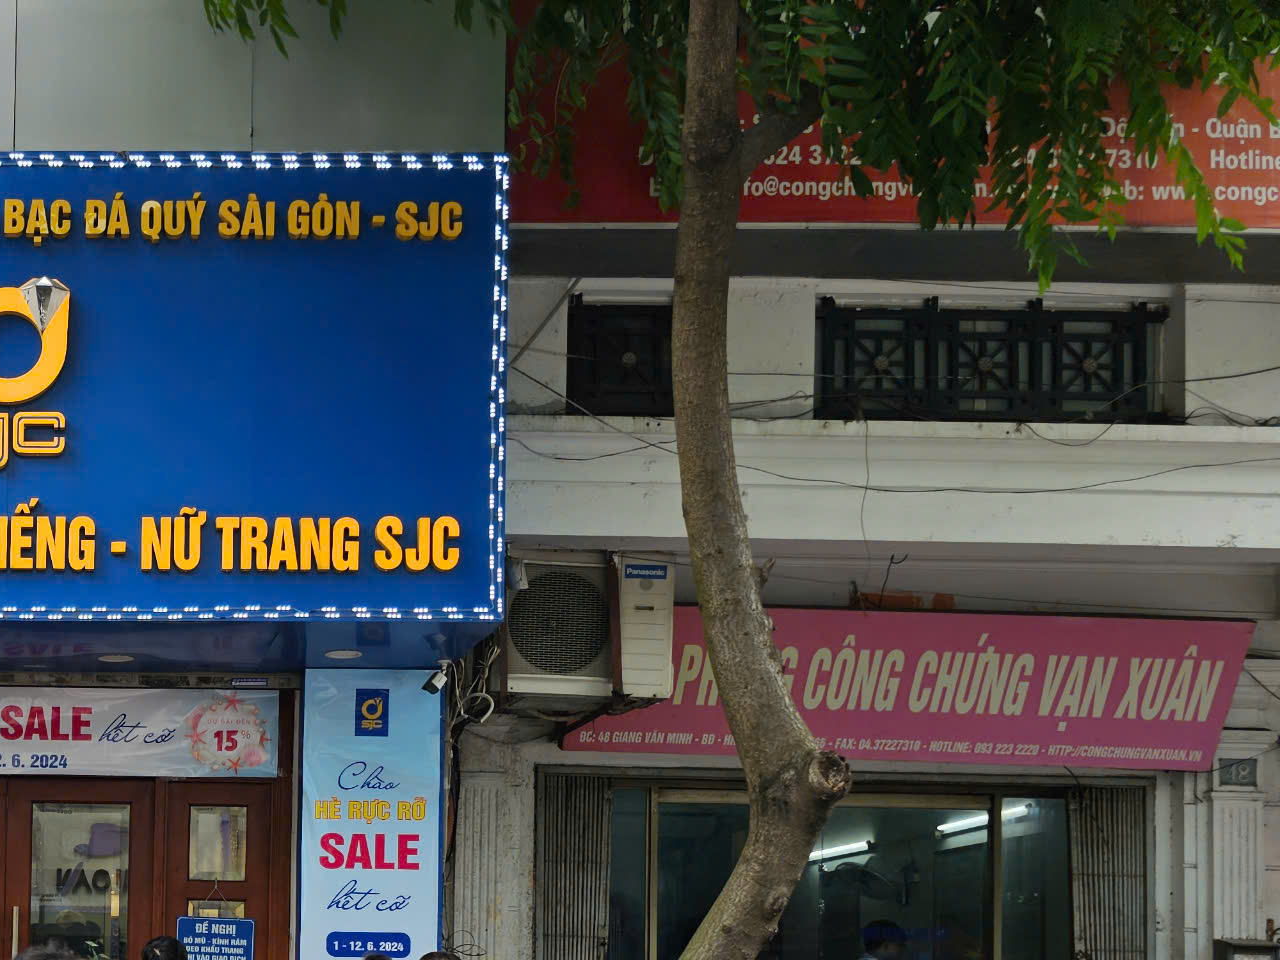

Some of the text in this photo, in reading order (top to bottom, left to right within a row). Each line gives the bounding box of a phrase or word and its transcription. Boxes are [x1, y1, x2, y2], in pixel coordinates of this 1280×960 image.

[1206, 117, 1262, 145] Quận
[4, 199, 71, 245] BẠC
[84, 192, 130, 238] ĐÁ
[141, 192, 207, 242] QUÝ
[218, 193, 276, 239] SÀI
[287, 193, 361, 239] GÒN
[371, 213, 386, 227] -
[395, 201, 463, 240] SJC
[111, 541, 127, 554] -
[141, 506, 207, 571] NỮ
[215, 515, 360, 571] TRANG
[374, 516, 460, 571] SJC
[626, 567, 665, 577] Panasonic
[803, 634, 905, 712] CÔNG
[909, 633, 1035, 716] CHỨNG
[1038, 655, 1119, 732] VẠN
[1114, 645, 1225, 723] XUÂN
[0, 705, 93, 742] SALE
[98, 713, 147, 742] hết
[598, 731, 610, 743] 48
[612, 731, 642, 743] GIANG
[645, 730, 665, 744] VĂN
[666, 733, 693, 745] MINH
[835, 738, 857, 749] FAX:
[929, 741, 971, 753] HOTLINE:
[30, 754, 68, 769] 2024
[337, 761, 400, 791] Chào
[315, 796, 428, 825] HÈ RỰC RỠ
[319, 832, 420, 870] SALE
[327, 879, 381, 911] hết
[211, 923, 237, 937] NGHỊ
[196, 953, 210, 960] VÀO
[333, 940, 339, 951] 1
[379, 941, 404, 952] 2024
